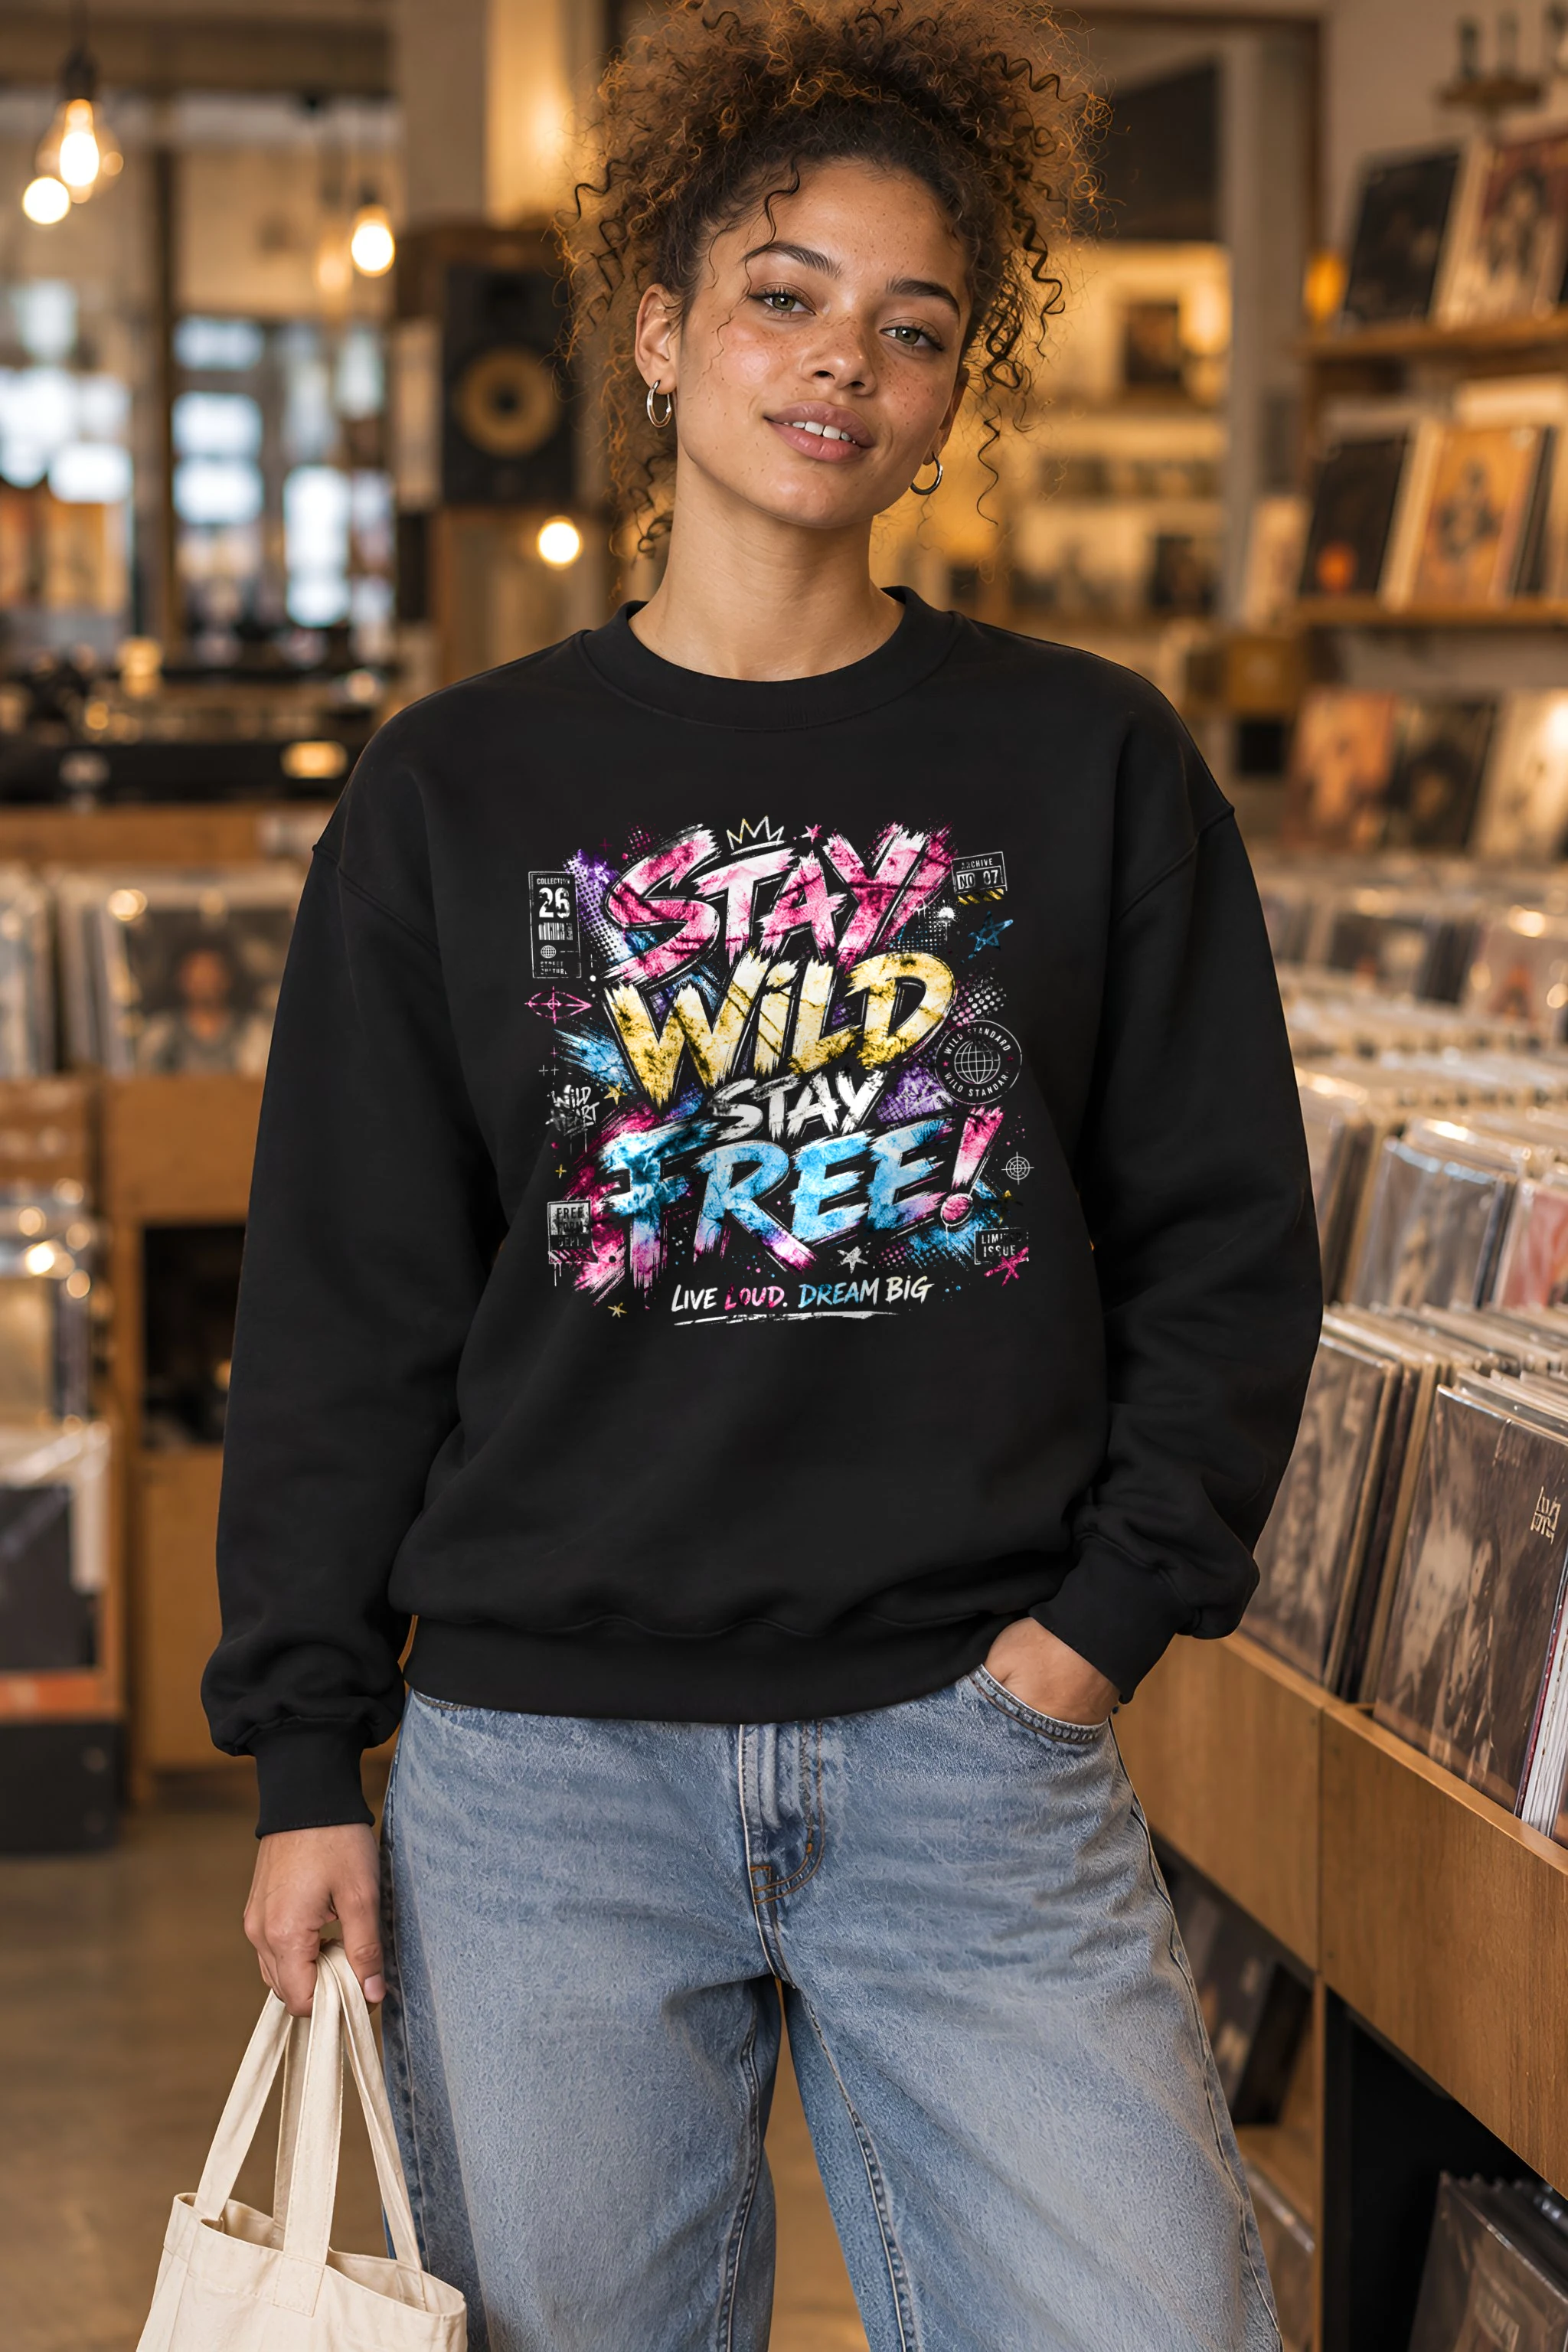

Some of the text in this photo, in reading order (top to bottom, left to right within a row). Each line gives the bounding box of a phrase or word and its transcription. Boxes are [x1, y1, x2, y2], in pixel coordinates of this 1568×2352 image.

[961, 858, 994, 870] ARCHIVE
[958, 869, 998, 889] NO 07
[538, 887, 570, 919] 26
[601, 824, 954, 978] STAY
[944, 1027, 1011, 1054] WILD STANDARD
[944, 1072, 964, 1093] WILD
[707, 1070, 888, 1142] STAY
[596, 1106, 1004, 1290] FREE!
[557, 1207, 584, 1219] FREE
[982, 1233, 1022, 1244] LIMI
[983, 1245, 1016, 1257] ISSUE
[671, 1285, 718, 1312] LIVE
[724, 1283, 788, 1310] LOUD.
[798, 1277, 880, 1308] DREAM
